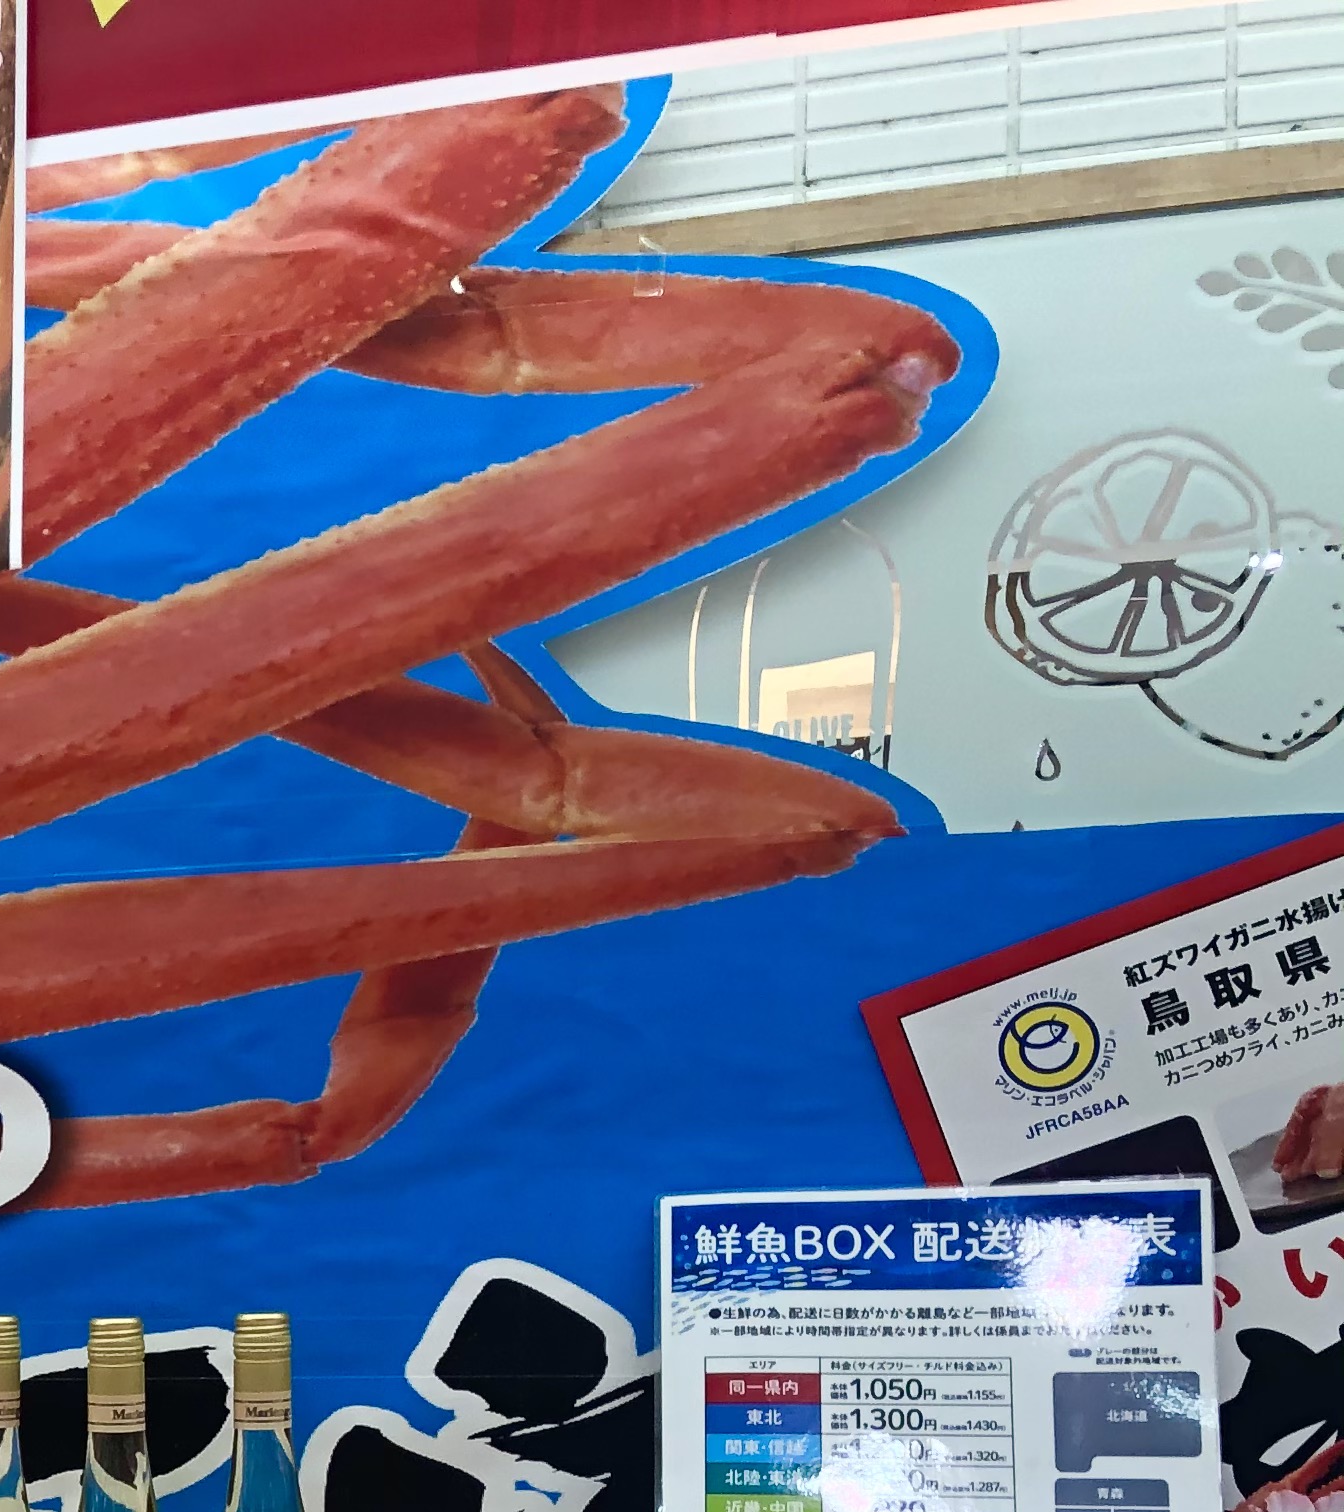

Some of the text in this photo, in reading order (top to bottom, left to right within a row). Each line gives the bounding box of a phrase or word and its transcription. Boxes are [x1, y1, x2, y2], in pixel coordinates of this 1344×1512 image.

[1145, 936, 1332, 1036] 鳥取県
[1025, 1094, 1130, 1141] JFRCA58AA
[695, 1221, 897, 1266] 鮮魚BOX
[748, 1360, 778, 1371] エリア
[728, 1379, 800, 1397] 同一県内
[850, 1378, 937, 1401] 1,050円
[745, 1409, 784, 1426] 東北
[850, 1407, 938, 1431] 1,300円
[1106, 1408, 1149, 1423] 北海道
